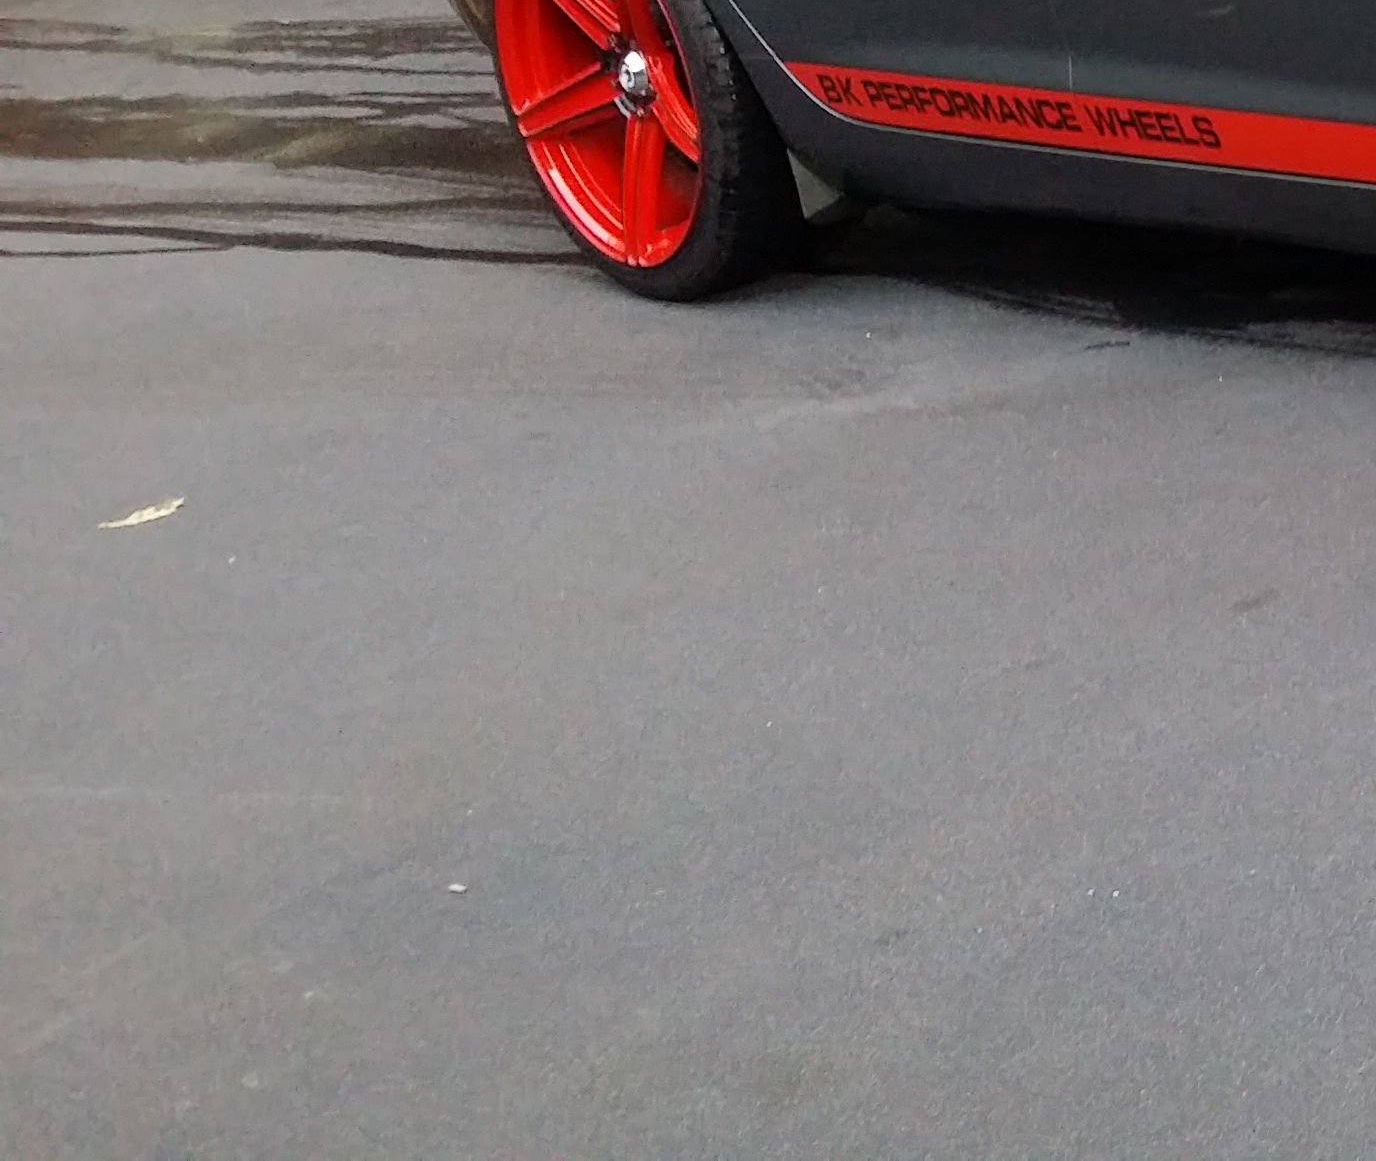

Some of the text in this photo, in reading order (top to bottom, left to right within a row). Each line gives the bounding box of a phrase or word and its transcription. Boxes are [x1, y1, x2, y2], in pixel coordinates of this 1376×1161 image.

[817, 74, 1222, 150] BK PERFORMANCE WHEELS
